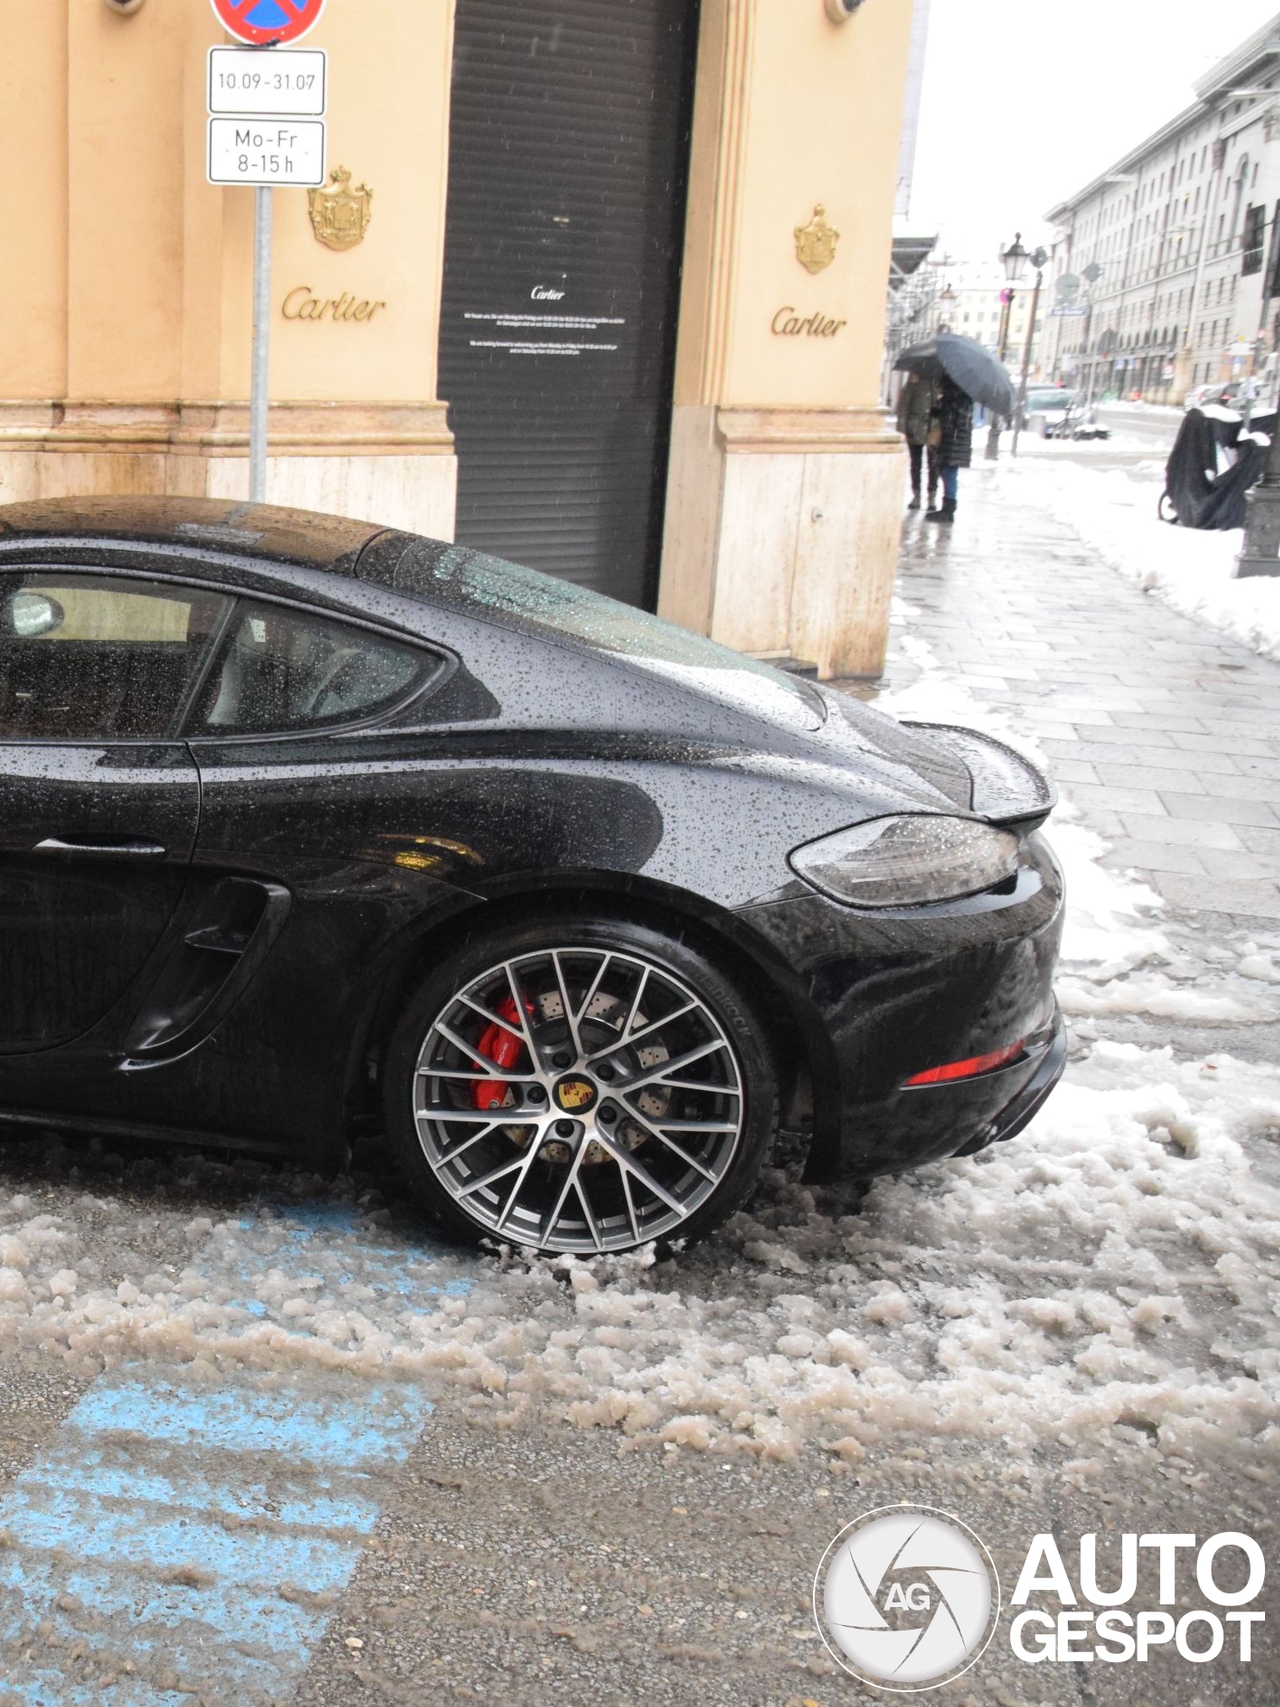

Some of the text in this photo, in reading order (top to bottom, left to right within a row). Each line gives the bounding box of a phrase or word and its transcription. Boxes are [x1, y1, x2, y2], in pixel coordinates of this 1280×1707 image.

[235, 129, 298, 148] Mo-Fr
[238, 154, 293, 173] 8-15 h
[531, 285, 566, 300] Cartier
[282, 286, 387, 321] Cartier
[771, 306, 847, 337] Cartier
